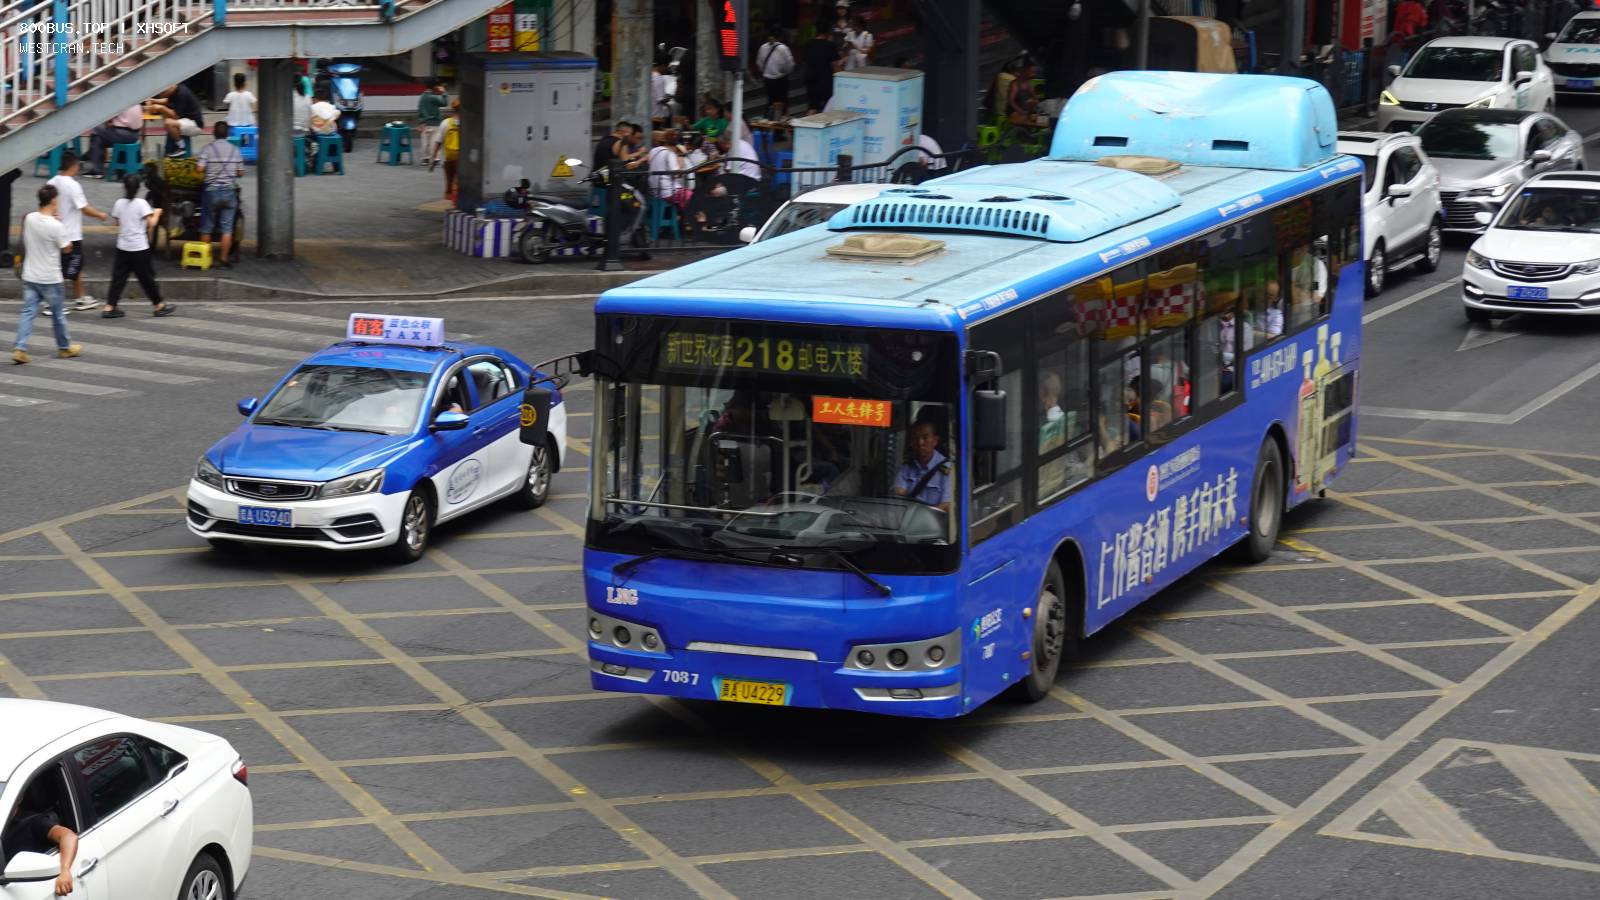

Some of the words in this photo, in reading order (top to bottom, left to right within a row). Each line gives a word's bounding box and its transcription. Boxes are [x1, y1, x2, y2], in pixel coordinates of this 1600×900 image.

[353, 318, 383, 336] 有客
[384, 330, 432, 341] TAXI
[667, 332, 734, 367] 新世界花园
[736, 337, 795, 371] 218
[797, 343, 863, 376] 邮电大楼
[819, 401, 885, 422] 工人先锋号
[1171, 466, 1239, 563] 携手向未来
[606, 586, 639, 606] LNG
[662, 669, 700, 685] 7087
